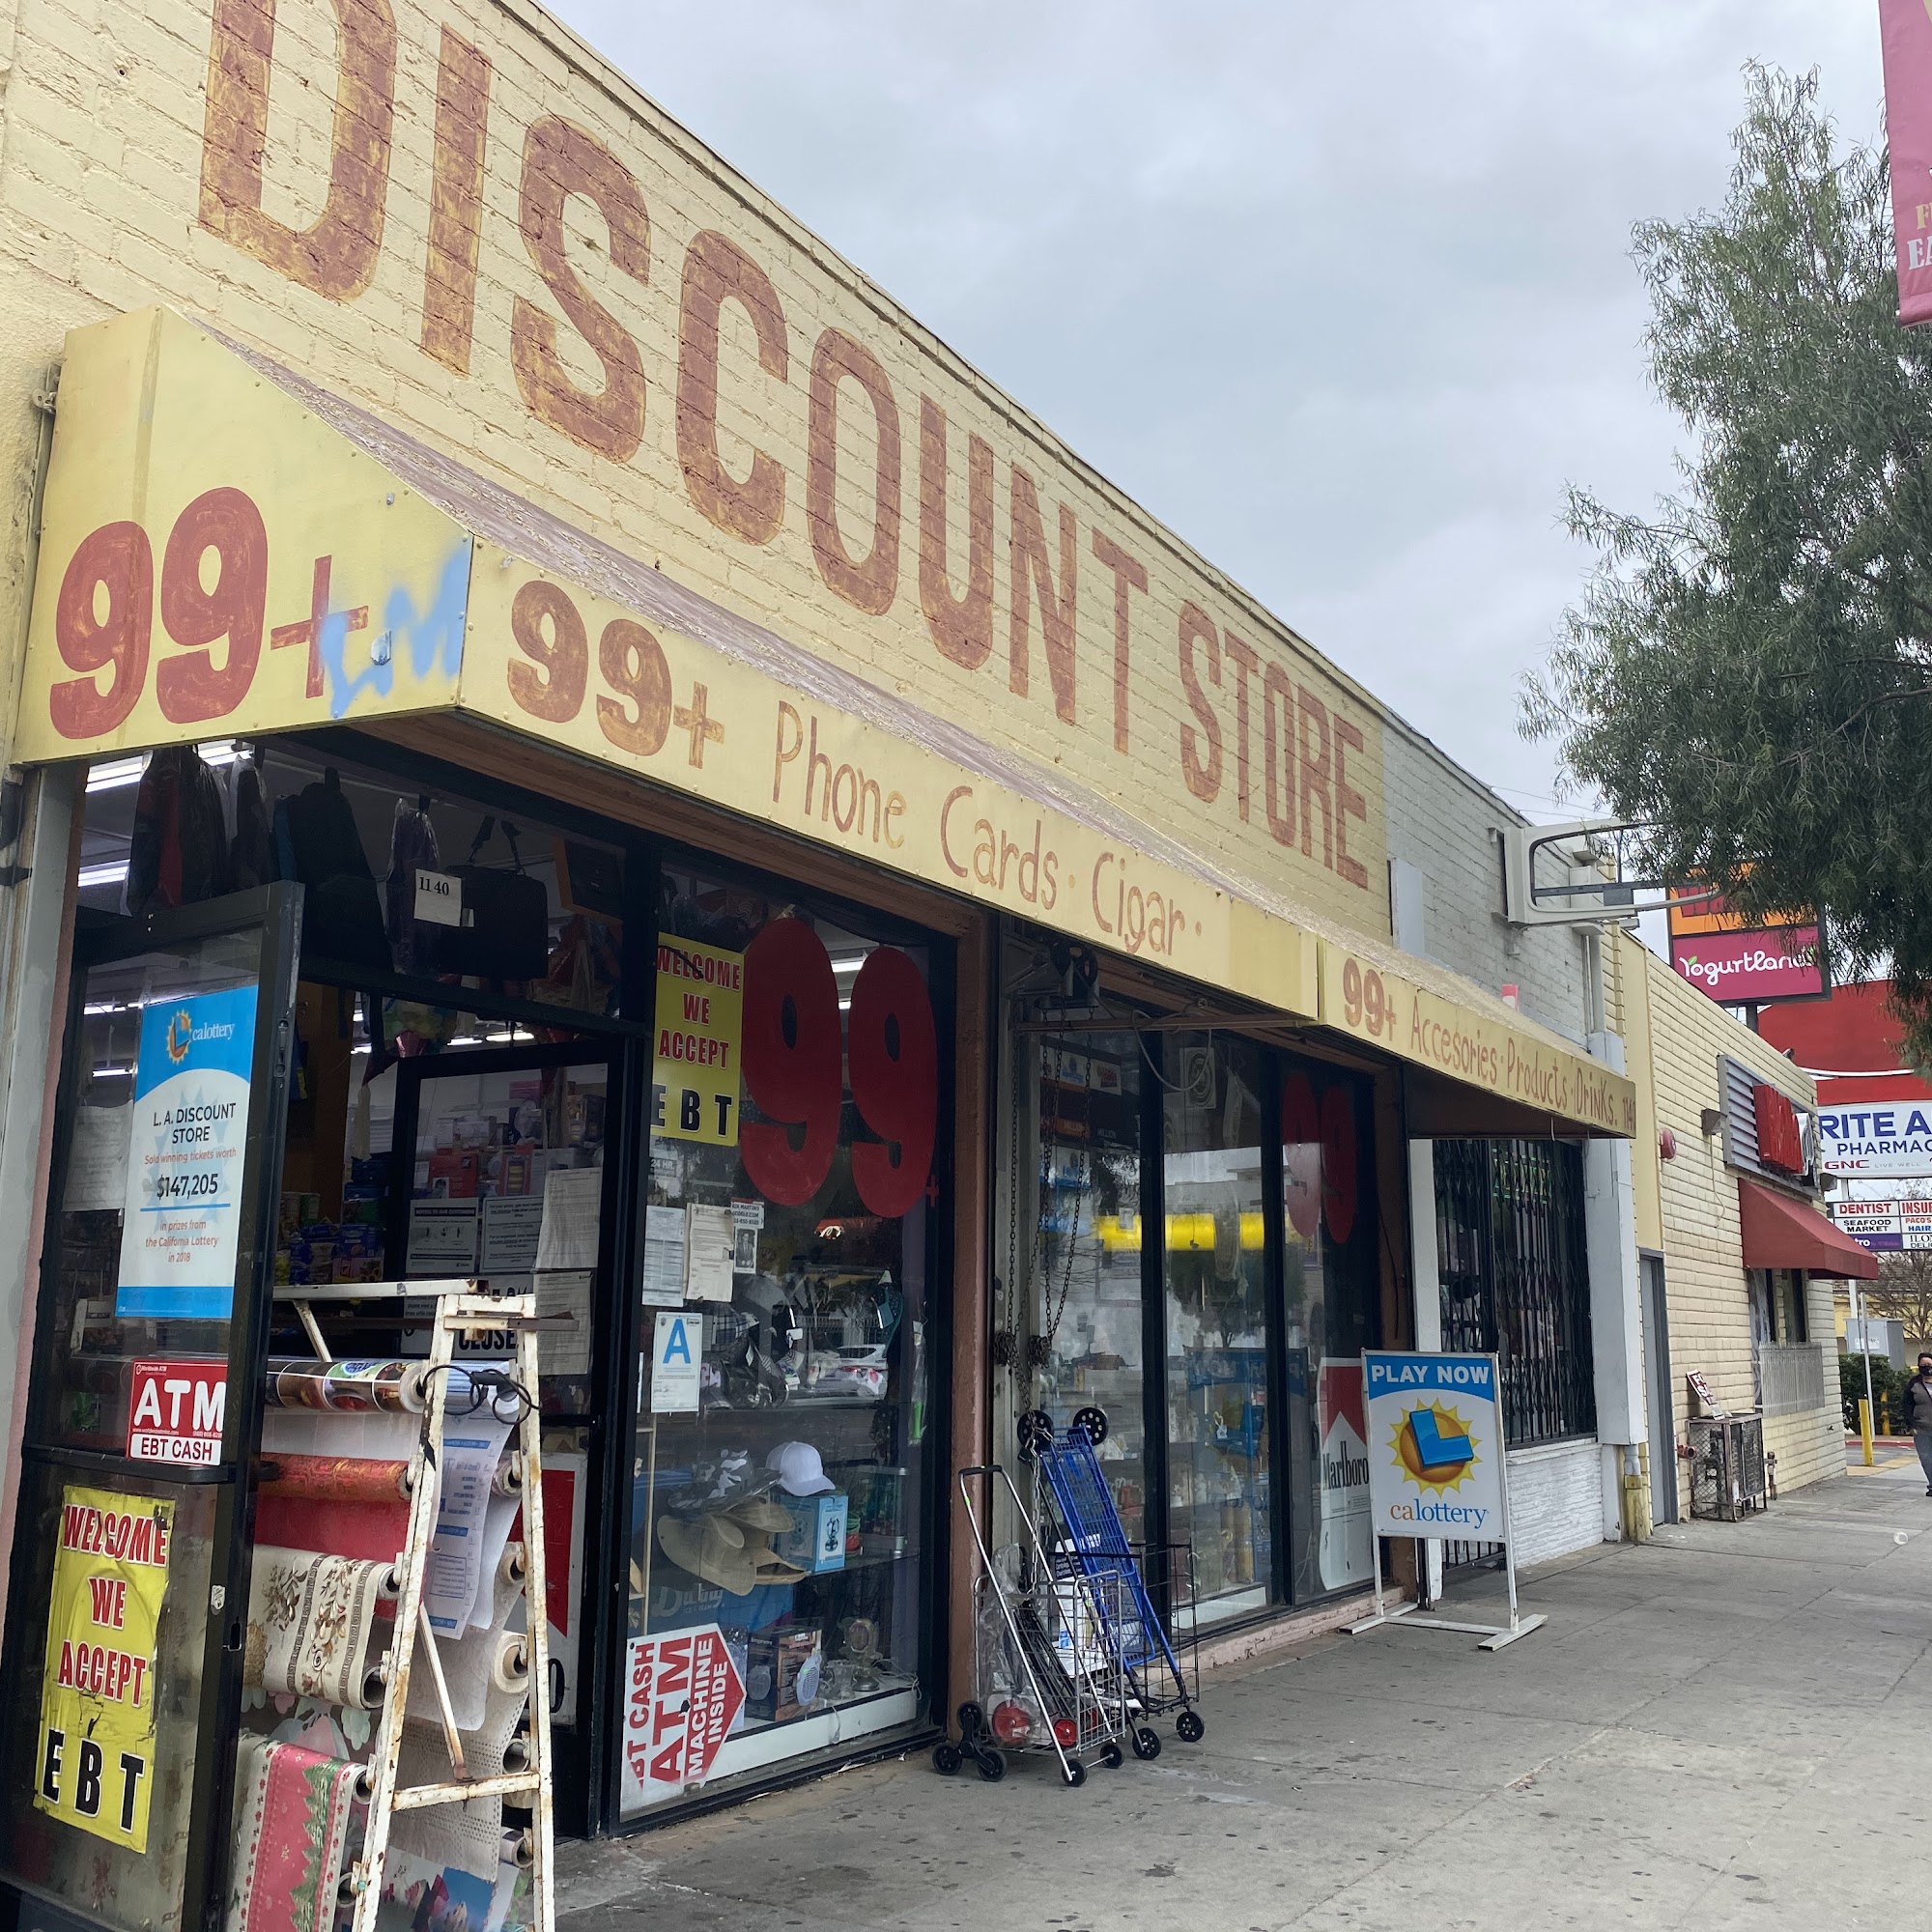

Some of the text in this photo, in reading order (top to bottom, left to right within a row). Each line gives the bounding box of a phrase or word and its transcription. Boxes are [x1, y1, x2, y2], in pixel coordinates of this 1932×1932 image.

[198, 0, 1368, 889] DISCOUNT STORE
[772, 700, 907, 849] Phone
[940, 785, 1059, 910] Cards
[1092, 852, 1186, 956] Cigar
[657, 946, 741, 991] WELCOME
[683, 992, 710, 1026] WE
[192, 1022, 235, 1041] calottery
[658, 1029, 729, 1069] ACCEPT
[1410, 996, 1497, 1086] Accesories
[1506, 1037, 1568, 1111] Products
[176, 1102, 237, 1123] DISCOUNT
[1820, 1111, 1896, 1140] RITE
[172, 1126, 210, 1144] STORE
[145, 1147, 237, 1165] Sold winning tickets worth
[1825, 1159, 1870, 1170] GNC
[156, 1173, 218, 1200] $147,205
[1839, 1203, 1891, 1214] DENTIST
[145, 1236, 219, 1248] the California Lottery
[160, 1219, 207, 1233] in prizes from
[1910, 1234, 1932, 1243] ILO
[168, 1252, 191, 1263] in 2018
[663, 1319, 691, 1364] A
[1372, 1365, 1490, 1384] PLAY NOW
[134, 1378, 226, 1432] ATM
[141, 1437, 213, 1461] EBT CASH
[1322, 1441, 1369, 1492] Marlboro
[1390, 1498, 1487, 1529] calottery
[63, 1503, 168, 1568] WELCOME
[88, 1576, 127, 1630] WE
[57, 1638, 146, 1708] ACCEPT
[627, 1642, 655, 1790] BT CASH
[649, 1636, 692, 1784] ATM
[688, 1637, 713, 1777] MACHINE
[708, 1661, 728, 1744] INSIDE
